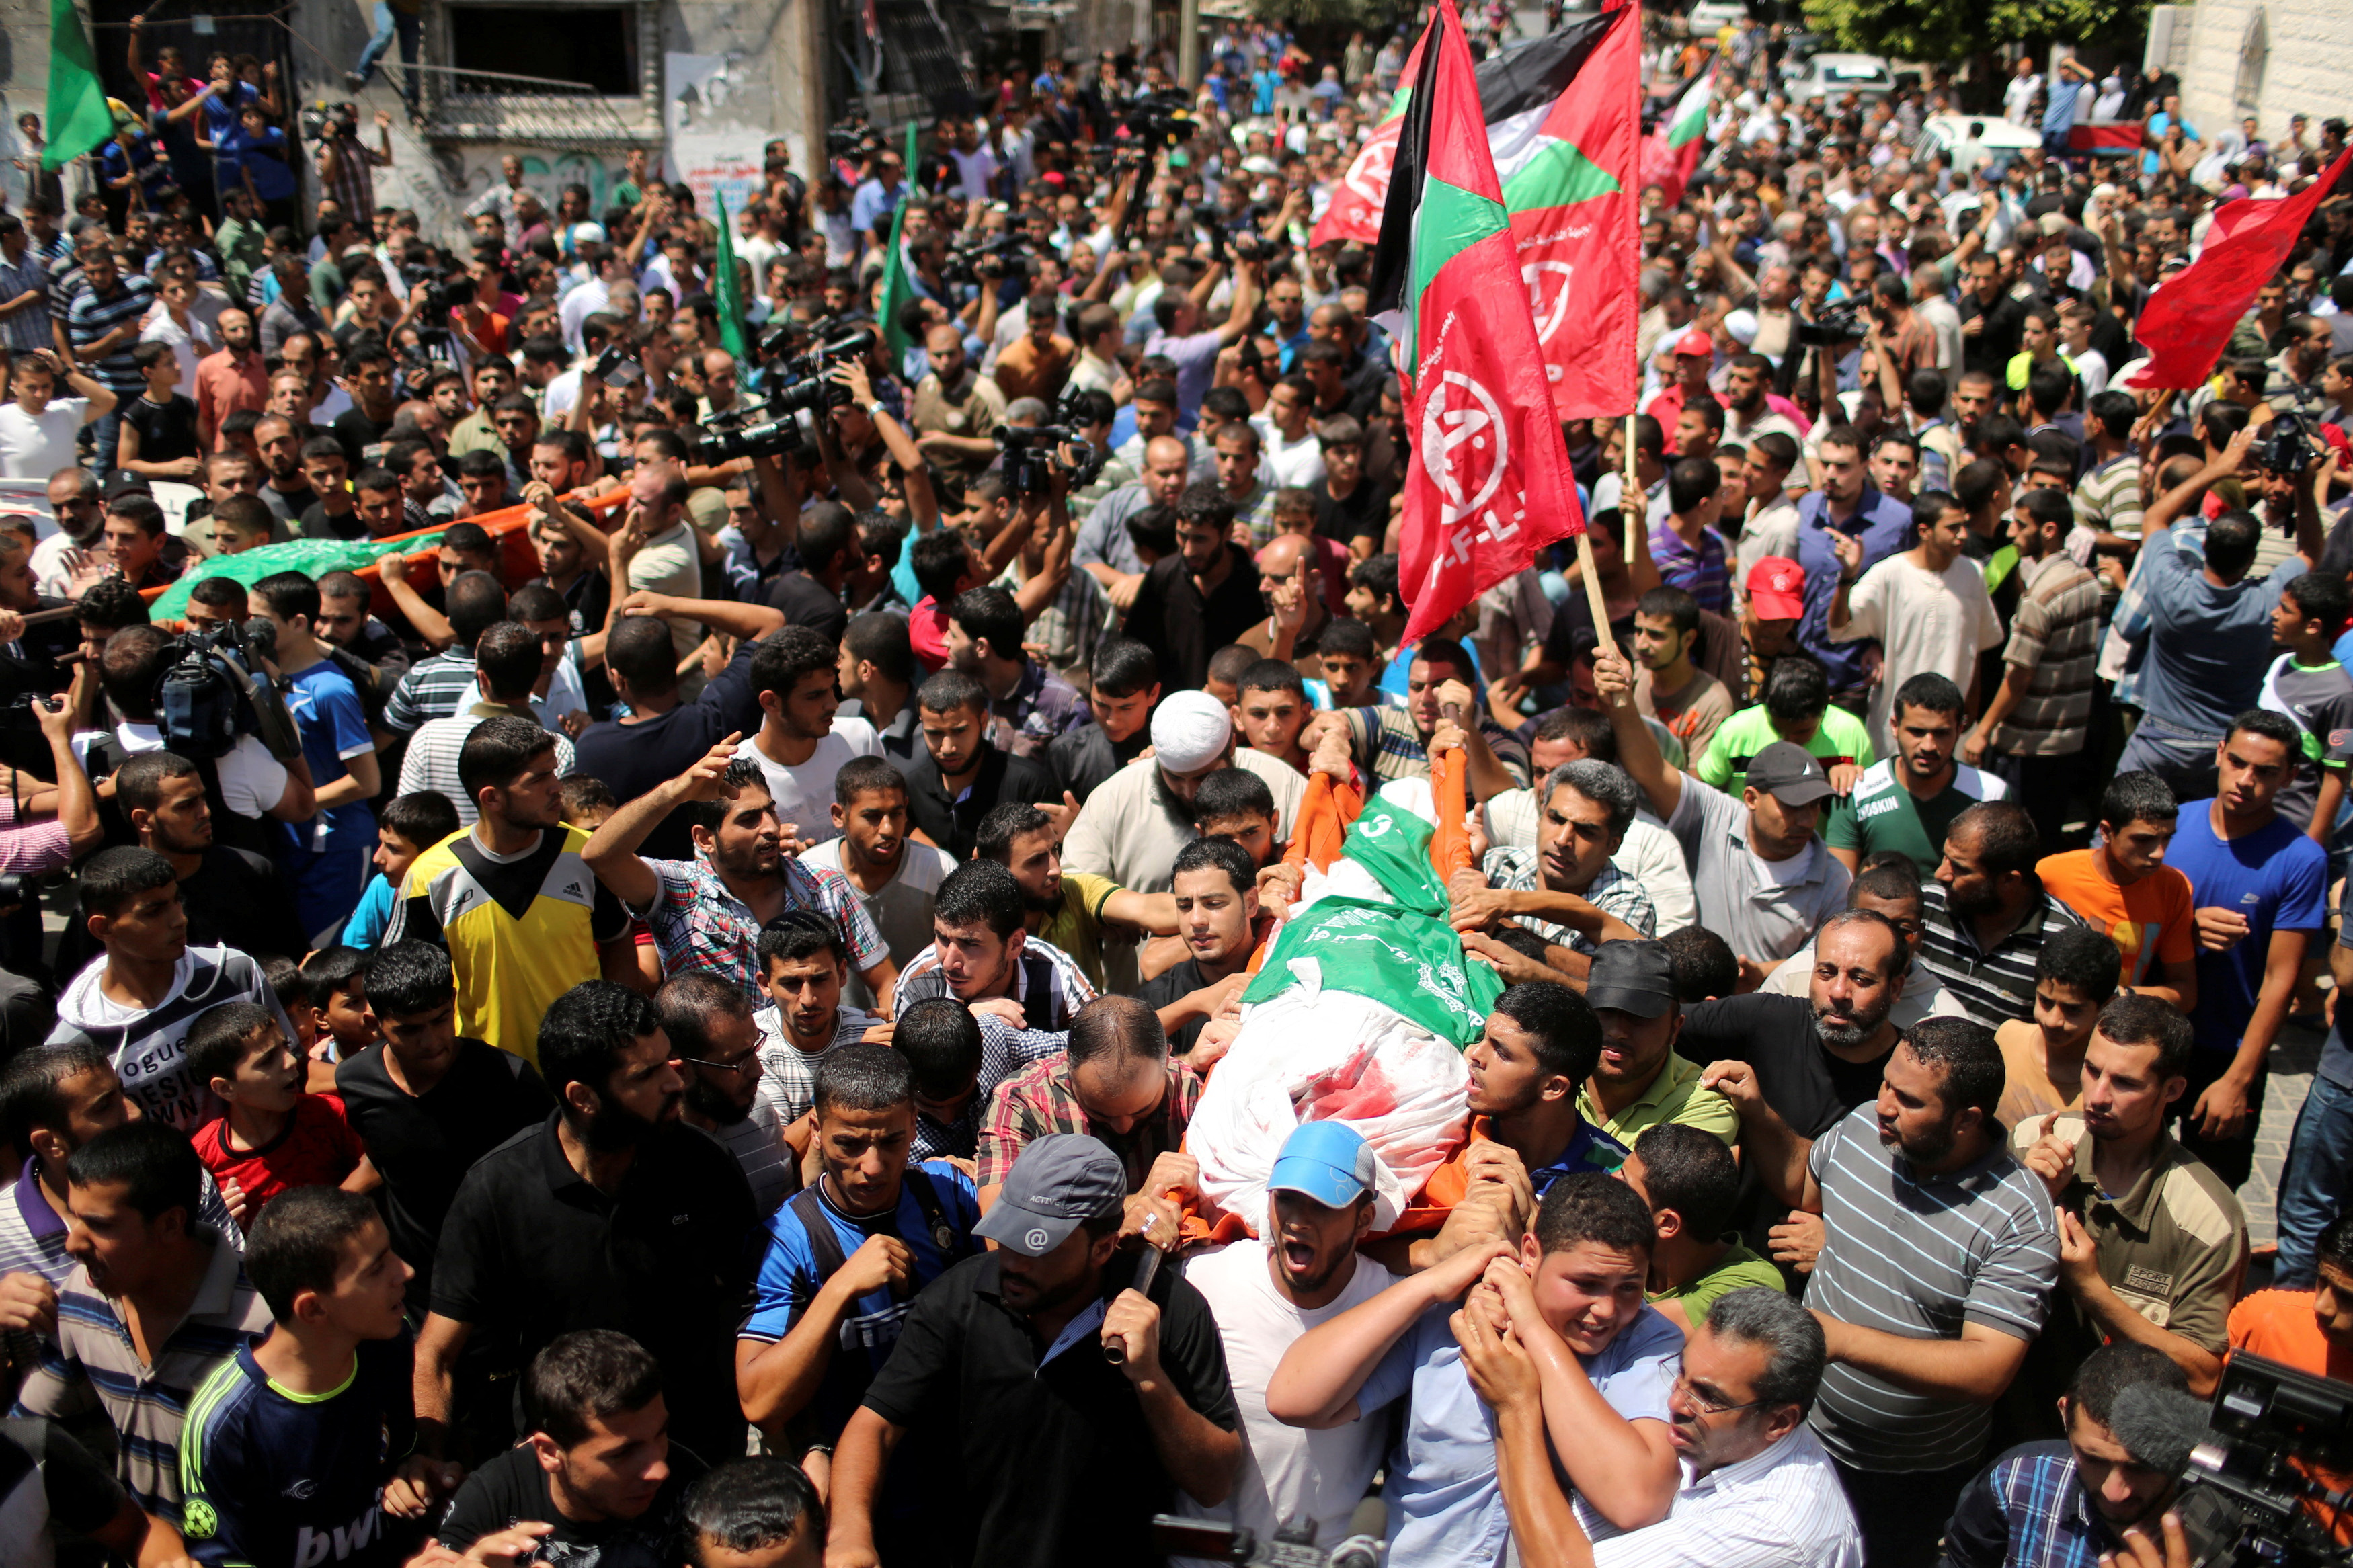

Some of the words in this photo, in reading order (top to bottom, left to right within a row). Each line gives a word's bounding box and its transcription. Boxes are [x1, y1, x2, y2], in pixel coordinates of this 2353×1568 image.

[562, 888, 584, 899] adidas
[2132, 1268, 2170, 1283] SPORT
[2128, 1277, 2169, 1294] FASHION
